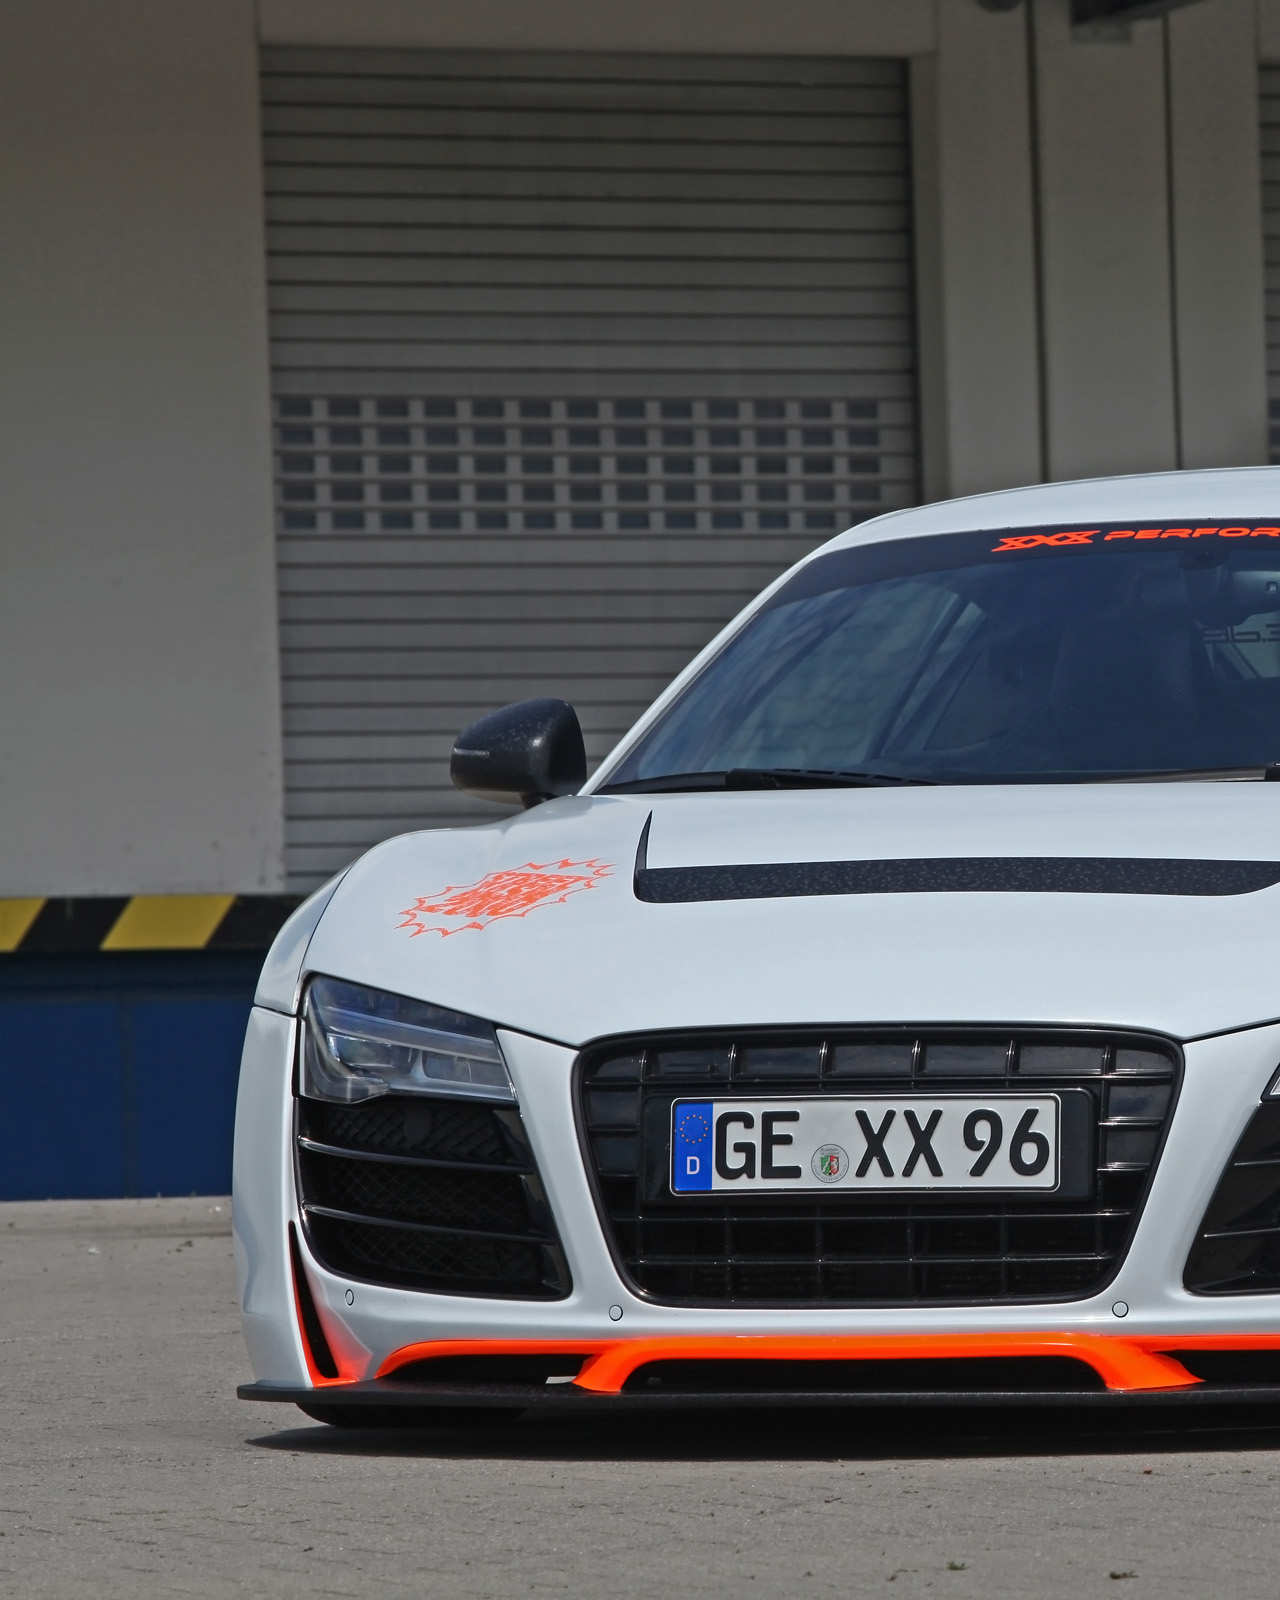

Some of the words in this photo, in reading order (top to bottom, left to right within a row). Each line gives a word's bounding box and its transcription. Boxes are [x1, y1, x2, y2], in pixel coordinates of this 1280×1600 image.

[686, 1155, 700, 1175] D
[715, 1110, 802, 1179] GE
[854, 1109, 945, 1178] XX
[962, 1108, 1050, 1177] 96
